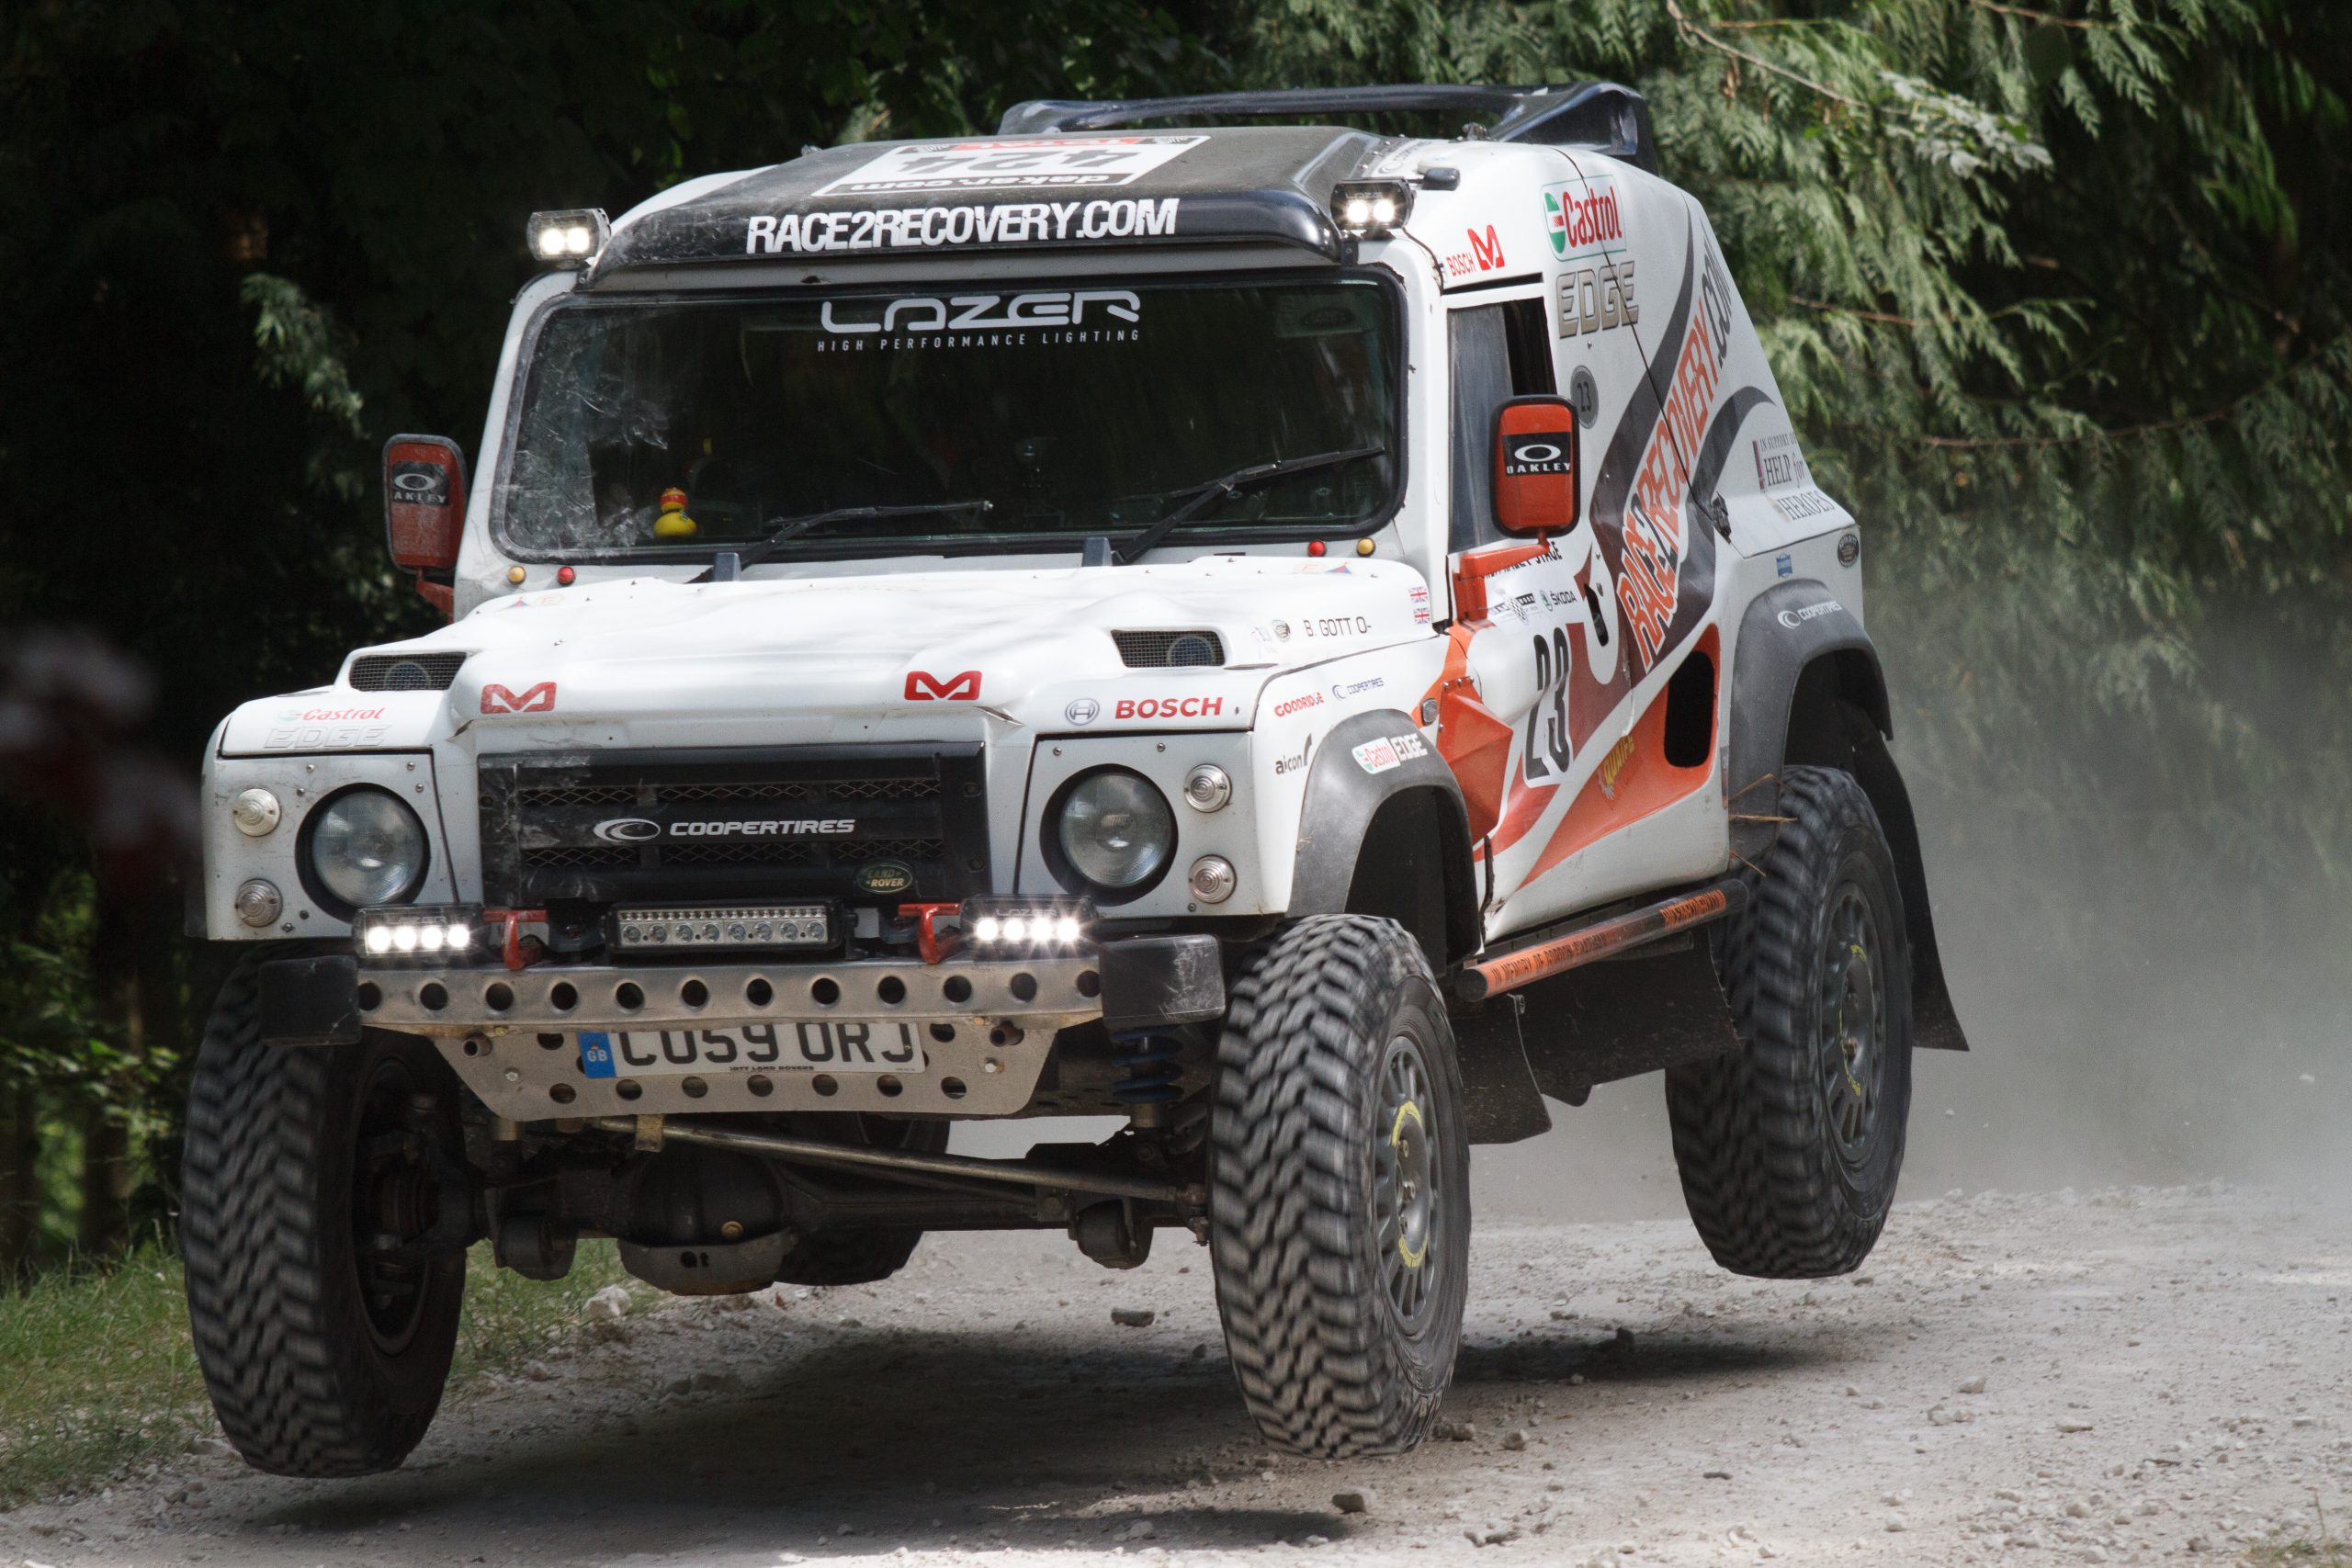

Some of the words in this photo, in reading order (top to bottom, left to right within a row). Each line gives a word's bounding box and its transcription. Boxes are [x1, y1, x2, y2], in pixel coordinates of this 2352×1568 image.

[848, 175, 1111, 191] dakar.com
[746, 197, 1181, 254] RACE2RECOVERY.COM
[1562, 186, 1623, 248] Castrol
[1446, 252, 1476, 276] BOSCH
[821, 290, 1141, 333] LAZER
[1555, 260, 1640, 339] EDGE
[817, 340, 864, 353] HIGH
[880, 333, 1027, 350] PERFORMANCE
[1042, 329, 1139, 344] LIGHTING
[1506, 462, 1571, 474] OAKLEY
[1763, 454, 1792, 487] HELP
[1777, 490, 1836, 521] HEROES
[1303, 619, 1317, 637] B.
[1318, 616, 1351, 637] GOTT
[301, 706, 387, 722] Castrol
[1114, 696, 1224, 719] BOSCH
[1525, 626, 1570, 781] 23
[263, 725, 392, 749] EDGE
[1390, 733, 1429, 762] EDGE
[1363, 741, 1397, 768] Castrol
[669, 818, 856, 836] COOPERTIRES
[870, 876, 905, 888] ROVER
[586, 1049, 608, 1063] GB
